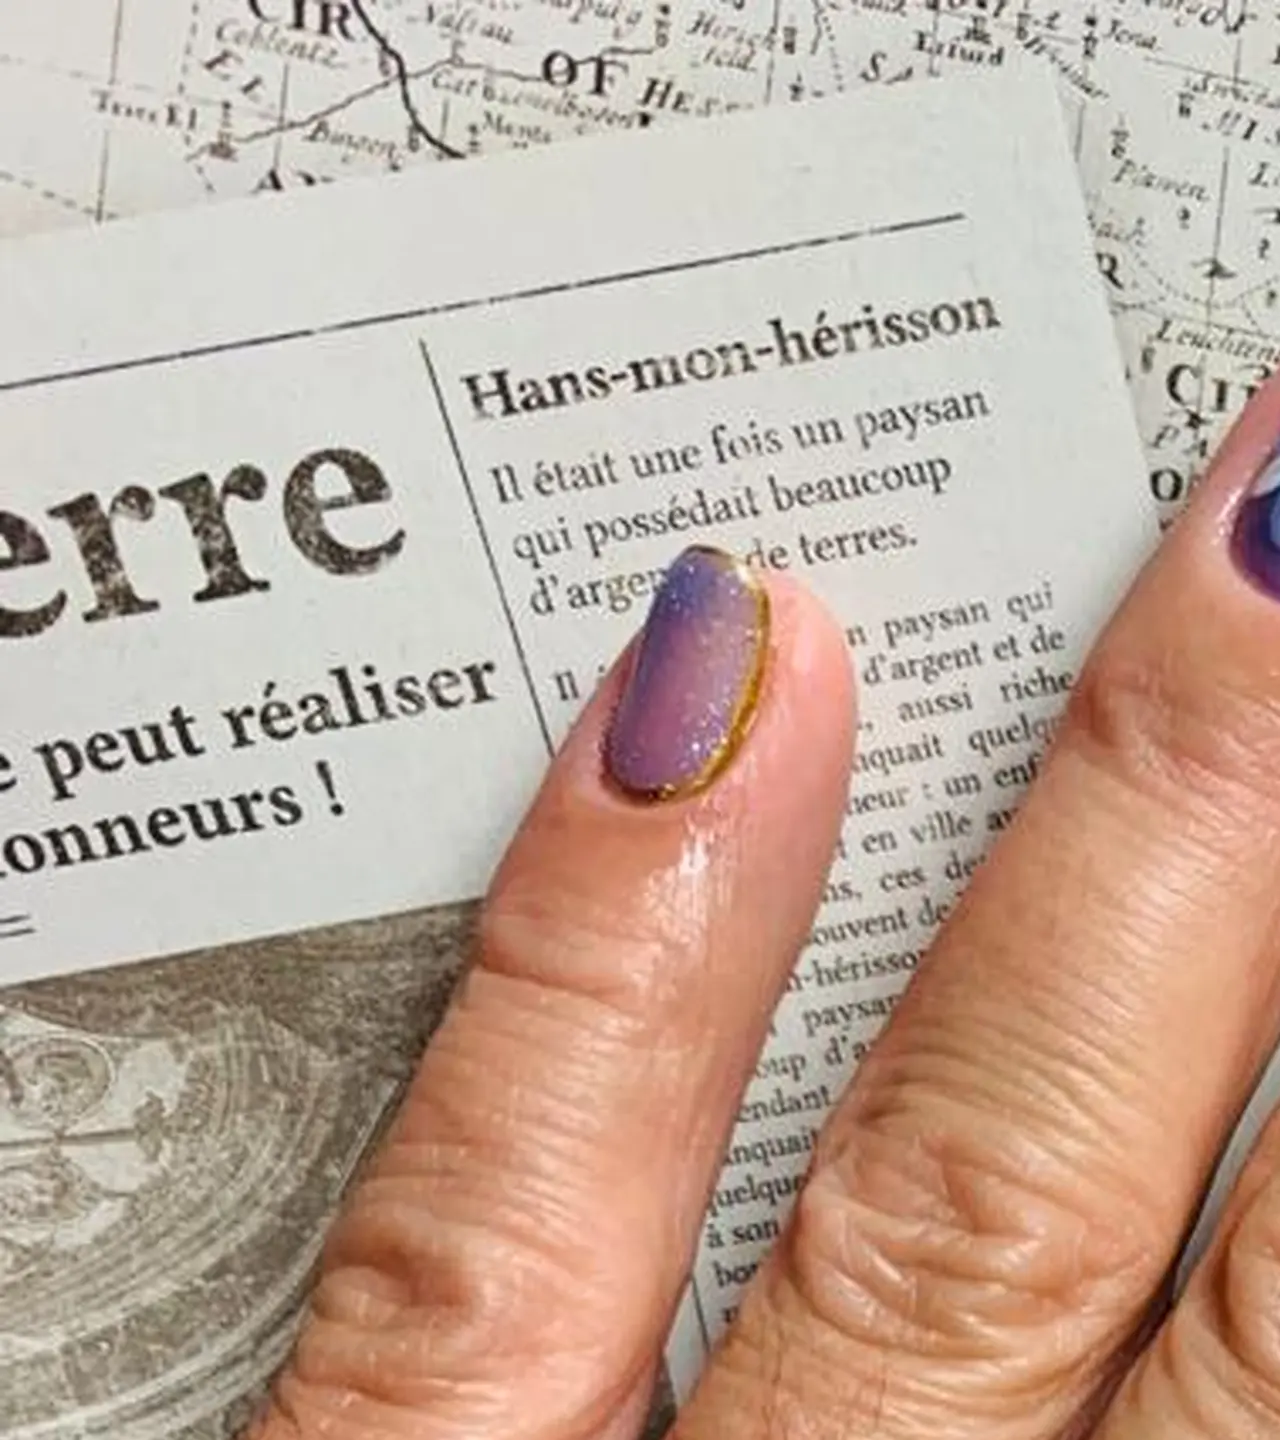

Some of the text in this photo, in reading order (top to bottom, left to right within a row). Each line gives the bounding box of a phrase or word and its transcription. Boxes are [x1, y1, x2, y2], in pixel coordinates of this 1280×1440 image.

[541, 49, 630, 96] OF
[460, 293, 1001, 420] Hans-mon-hérisson
[489, 389, 990, 503] Il était une fois un paysan
[513, 457, 952, 563] qui possédait beaucoup
[530, 523, 917, 615] d'arge de terres.
[883, 582, 1053, 648] paysan qui
[863, 625, 1066, 685] d'argent et de
[34, 658, 499, 800] peut réaliser
[898, 670, 1073, 723] aussi riche
[0, 761, 343, 877] onneurs !
[863, 810, 971, 855] en ville
[815, 910, 908, 946] ouvent
[732, 1218, 780, 1245] son
